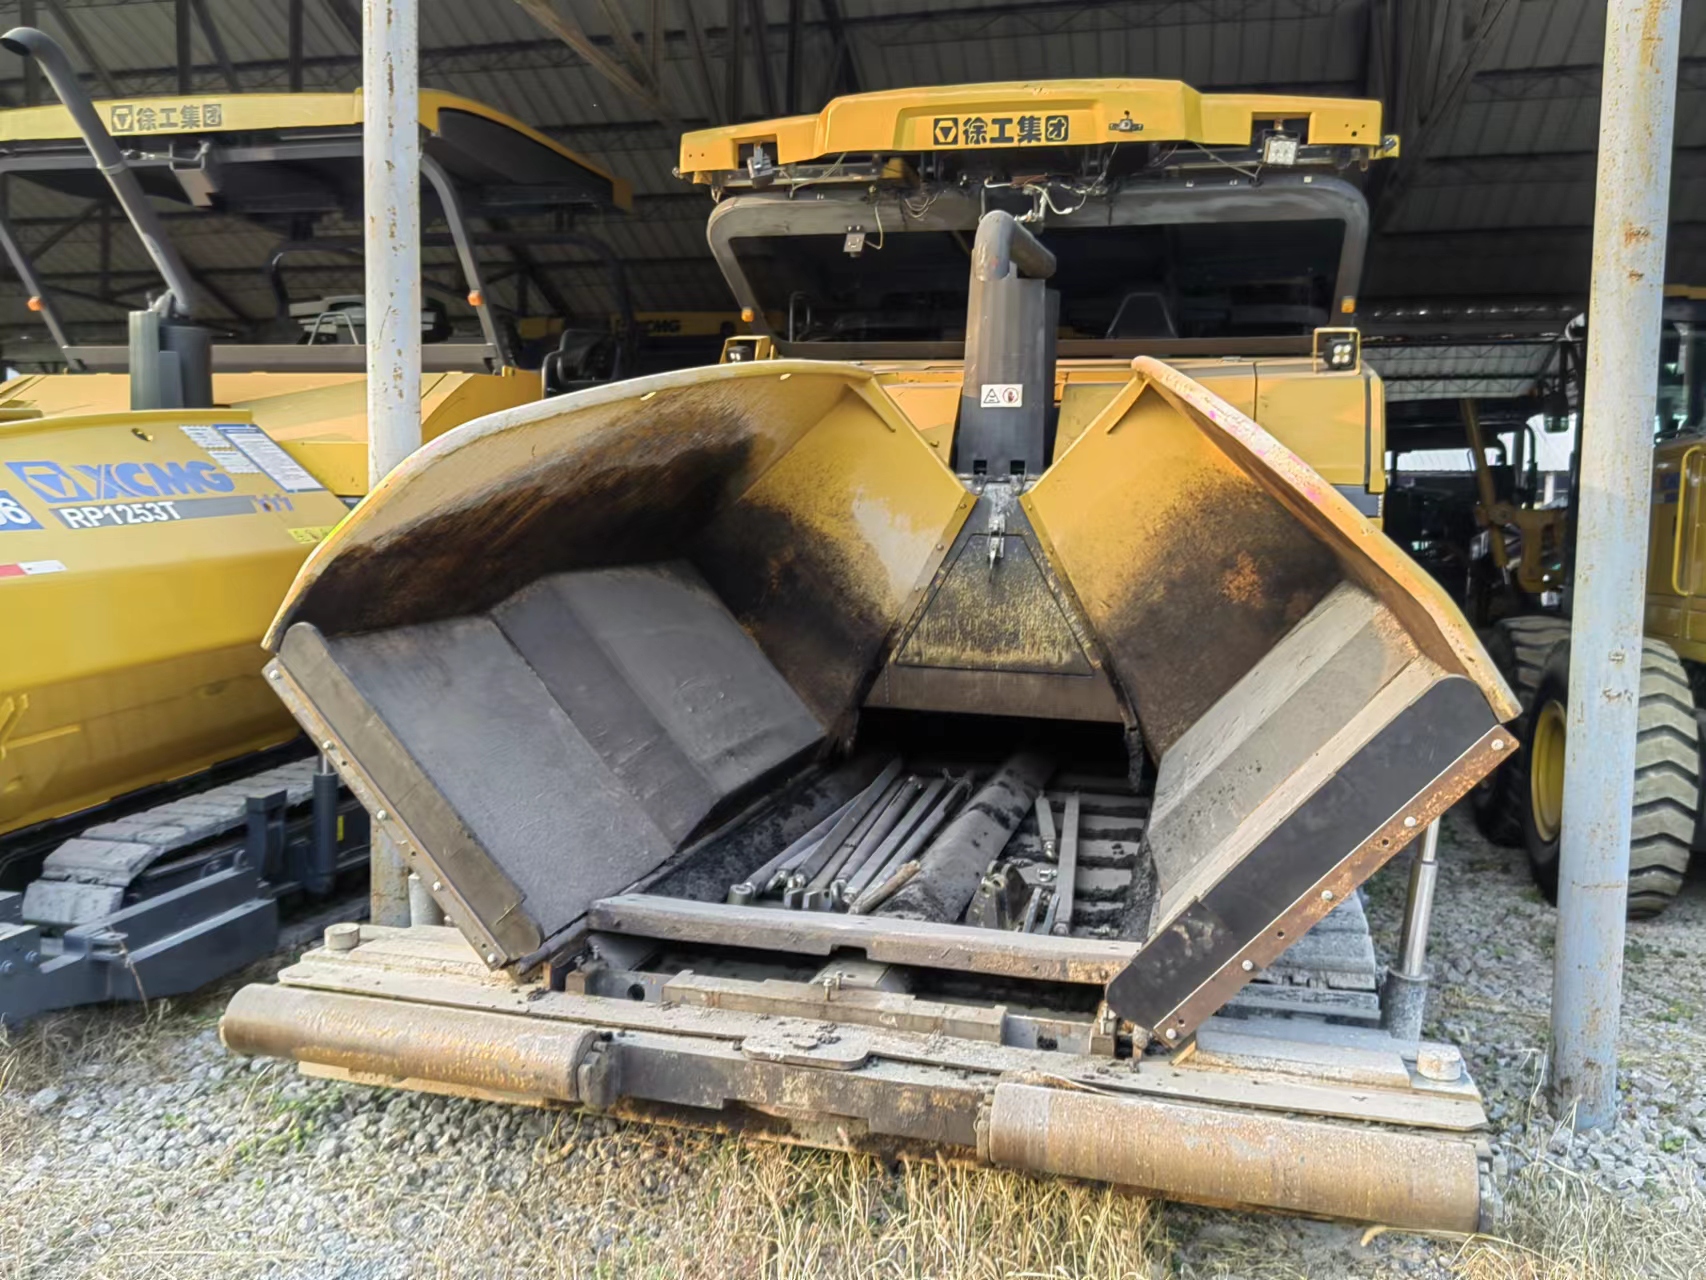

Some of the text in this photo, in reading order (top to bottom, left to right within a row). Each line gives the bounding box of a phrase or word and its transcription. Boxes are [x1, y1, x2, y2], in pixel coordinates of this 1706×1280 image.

[136, 104, 222, 131] 徐工集团
[963, 115, 1069, 145] 徐工集团
[72, 461, 236, 500] XCMG
[0, 497, 32, 526] 6
[59, 501, 181, 529] RP1253T
